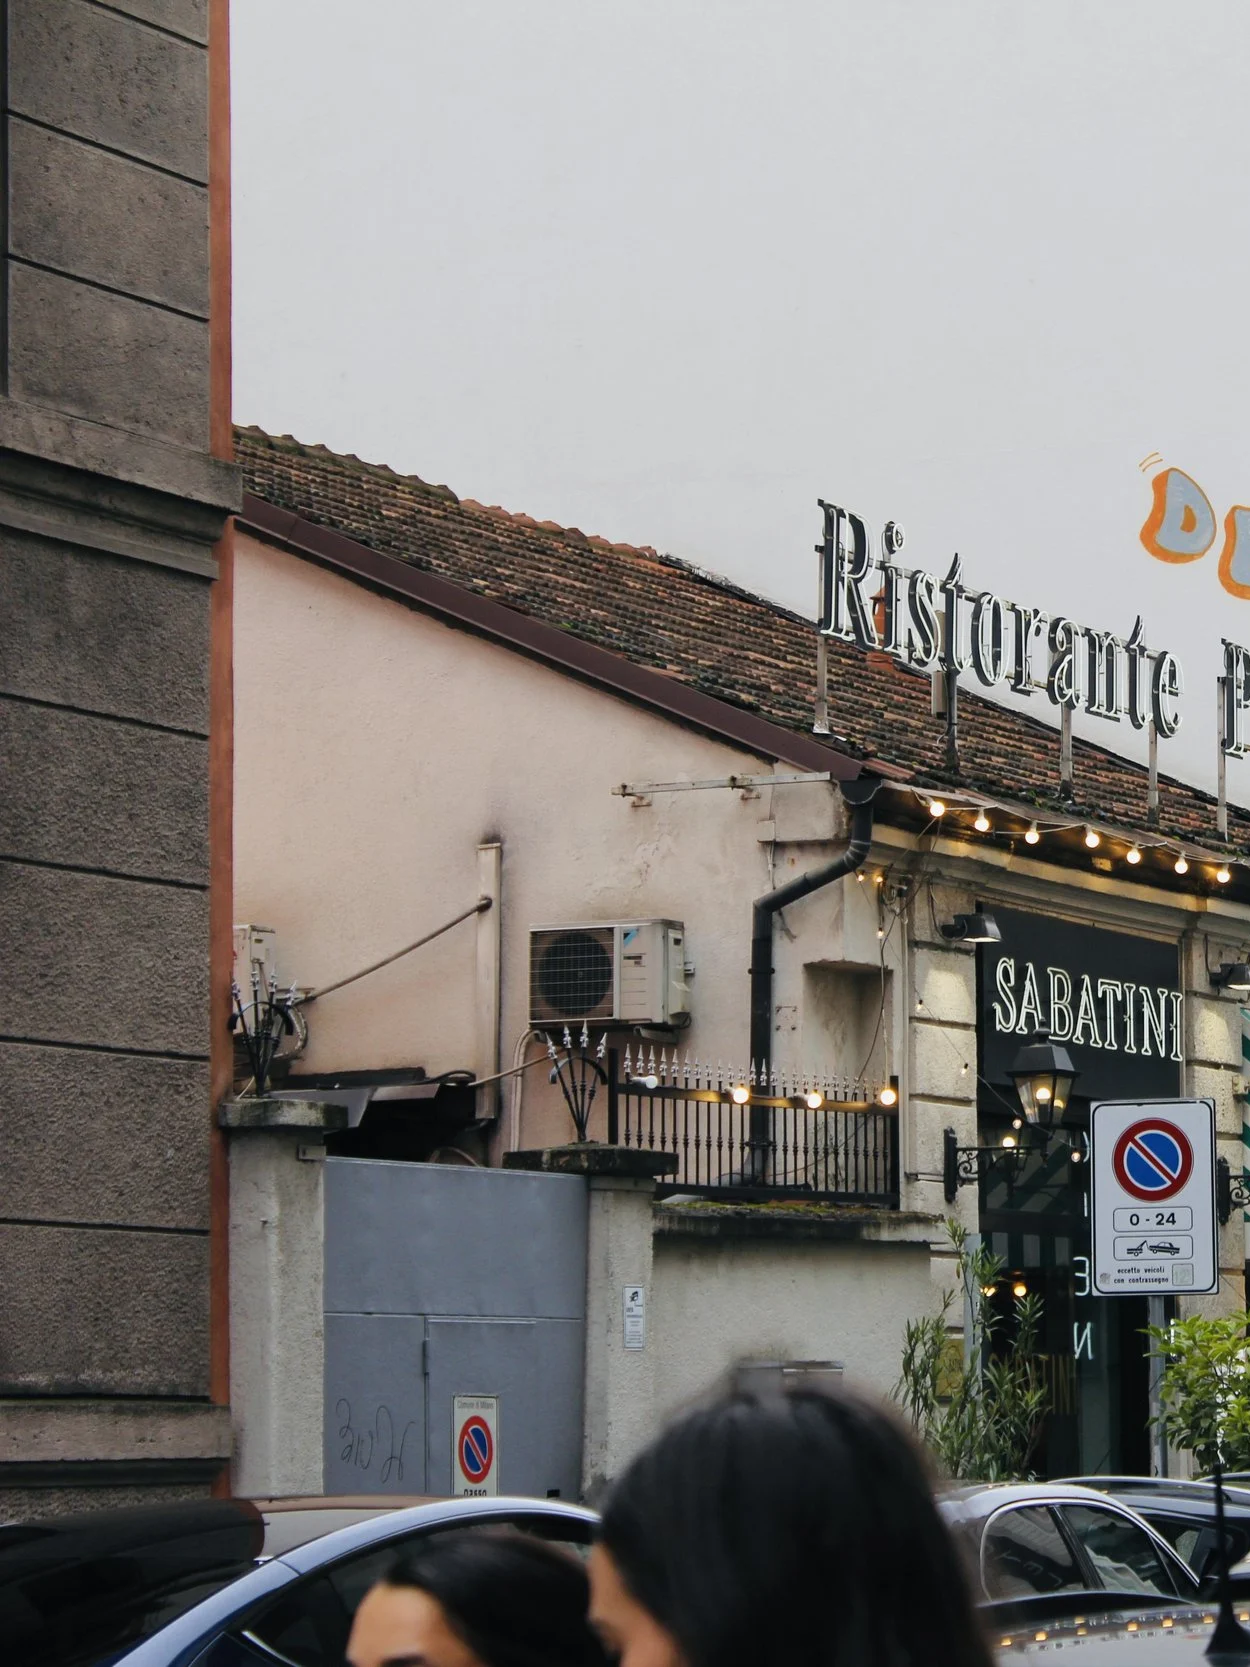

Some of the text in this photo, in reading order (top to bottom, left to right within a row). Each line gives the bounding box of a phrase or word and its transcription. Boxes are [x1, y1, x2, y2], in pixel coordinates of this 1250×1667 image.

[816, 498, 1184, 740] Ristorante
[992, 957, 1183, 1062] SABATINI
[1155, 1212, 1176, 1226] 24
[1144, 1265, 1165, 1274] veicoli
[1128, 1275, 1169, 1285] contrassegno
